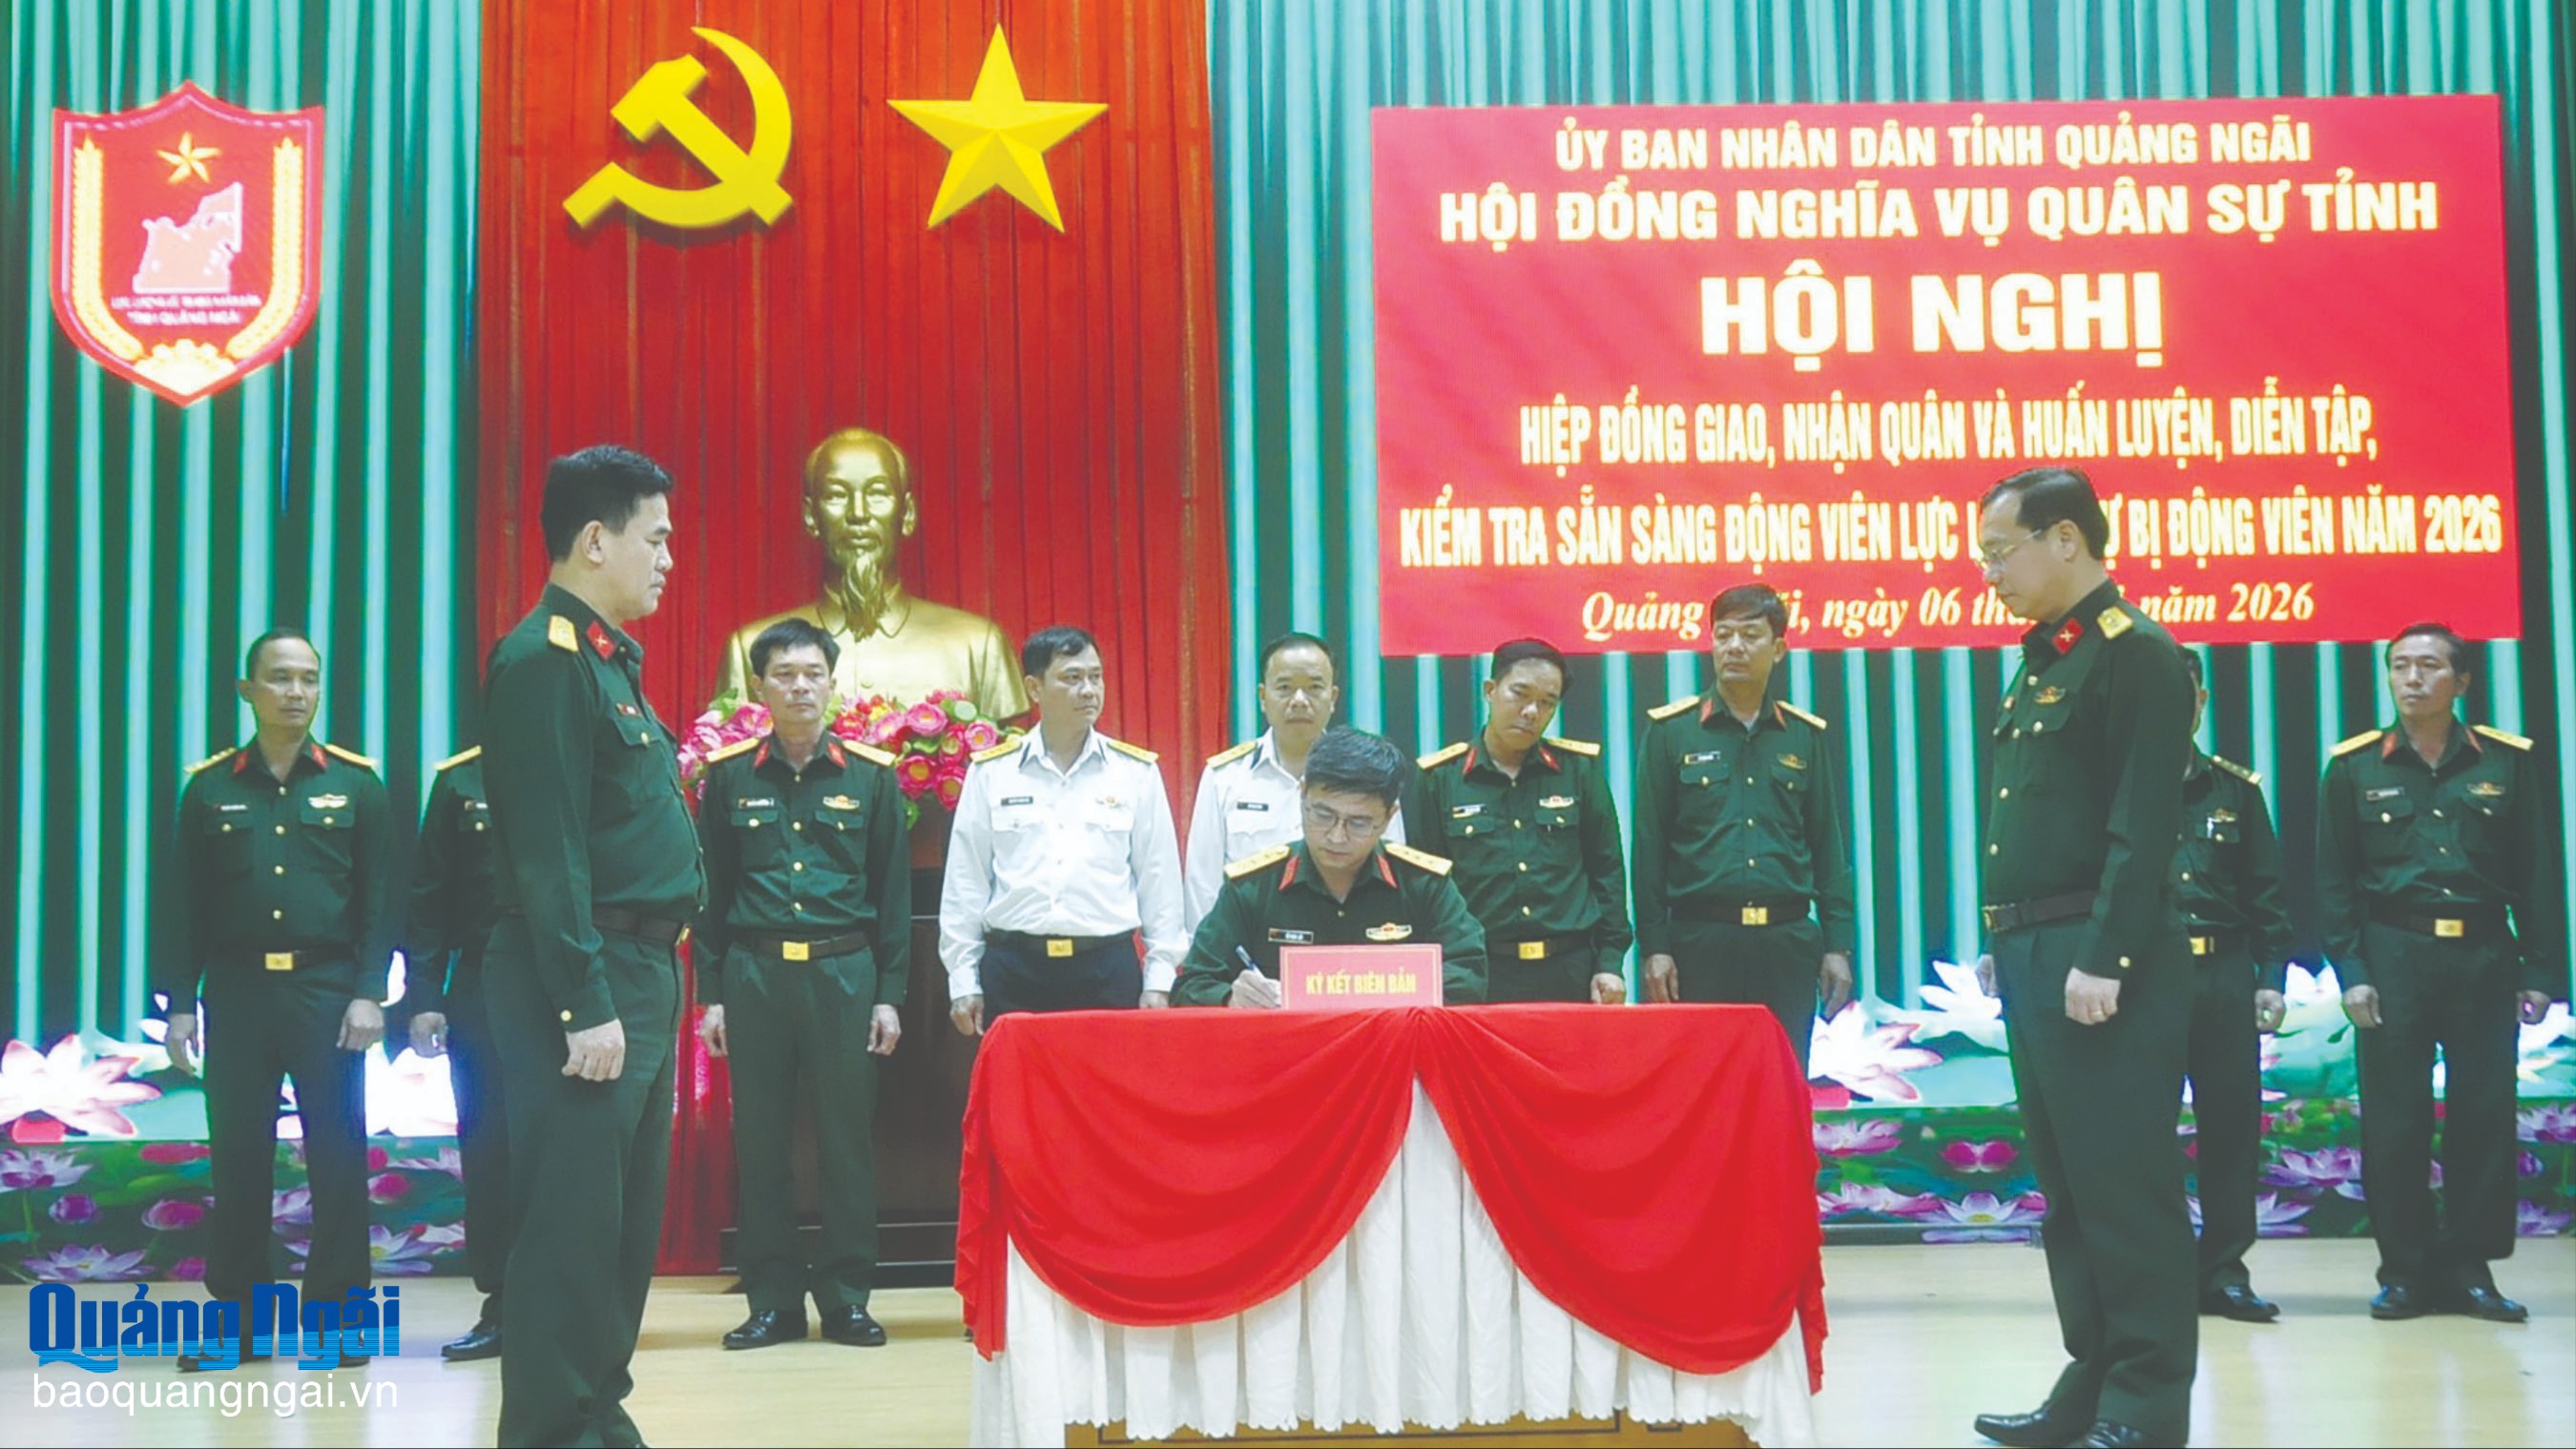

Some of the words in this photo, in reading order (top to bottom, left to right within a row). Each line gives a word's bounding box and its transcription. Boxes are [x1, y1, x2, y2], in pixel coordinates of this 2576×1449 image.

[1554, 115, 1610, 173] ỦY
[1619, 127, 1711, 172] BAN
[1719, 118, 1840, 171] NHÂN
[1848, 117, 1940, 169] DÂN
[1946, 111, 2046, 167] TỈNH
[2054, 110, 2200, 172] QUẢNG
[2209, 114, 2312, 164] NGÃI
[1439, 180, 1541, 253] HỘI
[1554, 173, 1719, 242] ĐỒNG
[1735, 178, 1920, 240] NGHĨA
[1932, 186, 2011, 248] VỤ
[2026, 175, 2190, 242] QUÂN
[2206, 178, 2293, 243] SỰ
[2300, 166, 2438, 232] TỈNH
[1700, 258, 1875, 373] HỘI
[1910, 271, 2164, 368] NGHỊ
[1519, 392, 1593, 479] HIỆP
[1597, 384, 1689, 465] ĐỒNG
[1693, 403, 1776, 469] GIAO,
[1781, 389, 1874, 475] NHẬN
[1879, 388, 1967, 467] QUÂN
[1971, 387, 2017, 460] VÀ
[2022, 380, 2110, 459] HUẤN
[2115, 385, 2224, 470] LUYỆN,
[2230, 376, 2307, 456] DIỄN
[2310, 383, 2378, 467] TẬP,
[1399, 483, 1484, 568] KIỂM
[1486, 505, 1551, 567] TRA
[1555, 484, 1625, 567] SẴN
[1630, 492, 1719, 566] SÀNG
[1722, 491, 1813, 576] ĐỘNG
[1818, 489, 1893, 563] VIÊN
[1898, 495, 1960, 573] LỰC
[2127, 498, 2162, 570] BỊ
[2166, 486, 2256, 569] ĐỘNG
[2260, 484, 2336, 555] VIÊN
[2340, 484, 2418, 554] NĂM
[2422, 494, 2503, 553] 2026
[1581, 590, 1705, 642] Quảng
[1820, 587, 1909, 638] ngày
[1919, 587, 1963, 627] 06
[2138, 586, 2217, 623] năm
[2227, 582, 2315, 622] 2026
[1326, 968, 1351, 995] KẾT
[1354, 970, 1385, 995] BIÊN
[1387, 965, 1417, 994] BẢN
